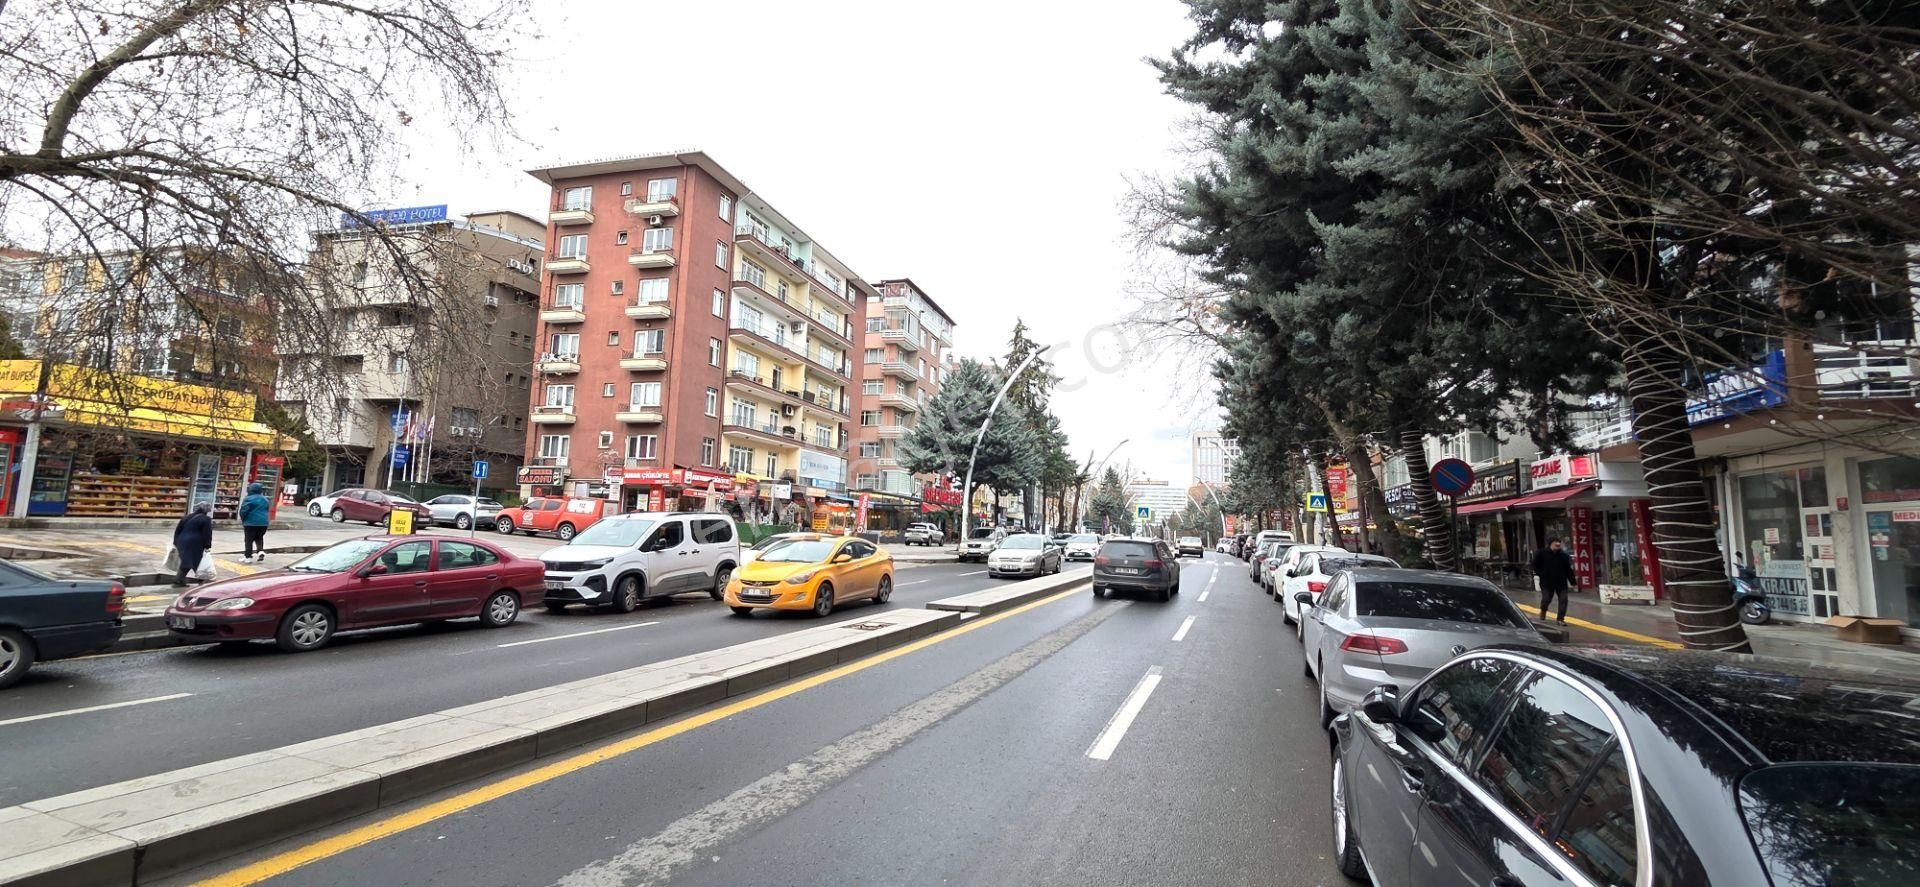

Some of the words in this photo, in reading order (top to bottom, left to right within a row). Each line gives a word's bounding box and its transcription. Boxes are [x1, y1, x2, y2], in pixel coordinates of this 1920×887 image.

[410, 207, 443, 220] HOTEL
[1531, 461, 1561, 479] ECZANE
[519, 475, 552, 483] SALONU
[1578, 509, 1590, 585] ECZANE
